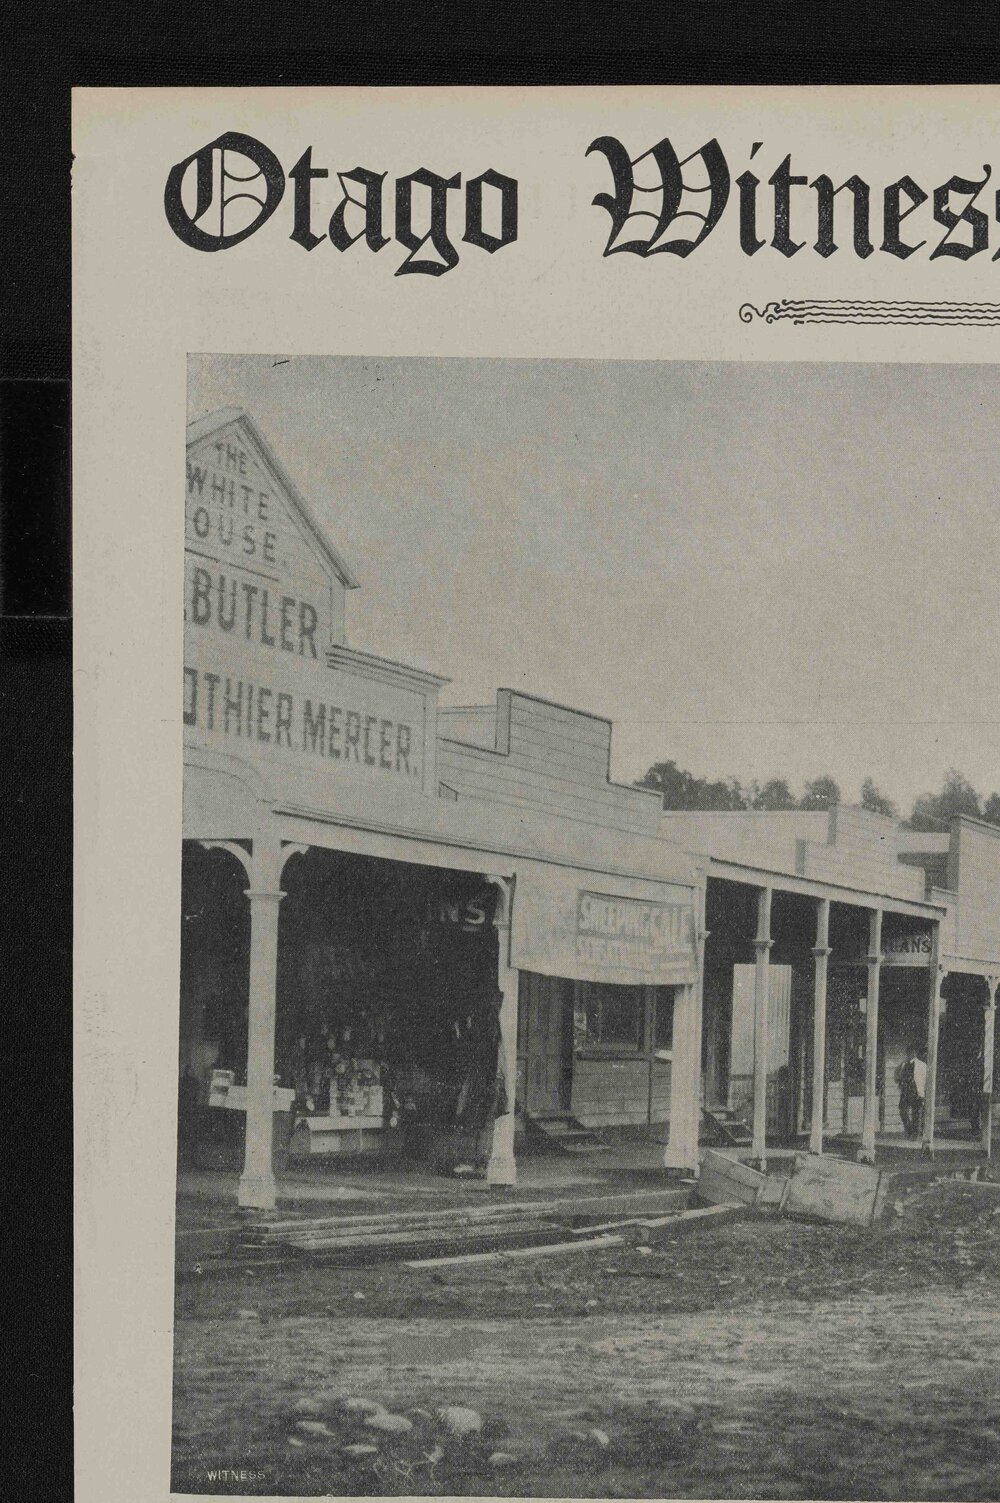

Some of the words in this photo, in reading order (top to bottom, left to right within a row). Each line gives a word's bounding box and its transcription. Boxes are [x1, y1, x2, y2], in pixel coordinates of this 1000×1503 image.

[164, 132, 518, 277] Otago
[214, 443, 247, 476] THE
[186, 462, 270, 522] WHITE
[207, 1470, 266, 1482] WITNESS
